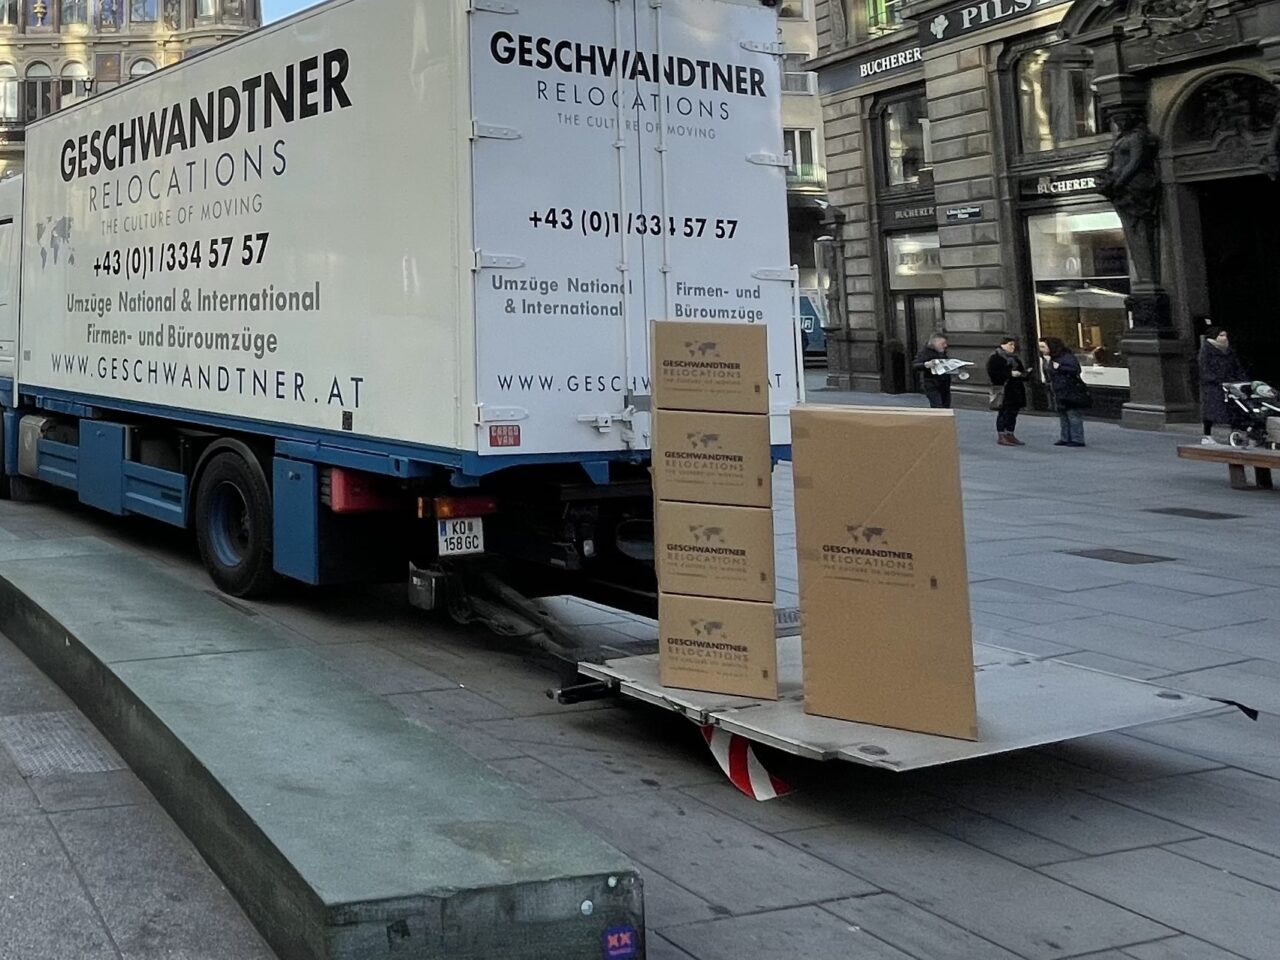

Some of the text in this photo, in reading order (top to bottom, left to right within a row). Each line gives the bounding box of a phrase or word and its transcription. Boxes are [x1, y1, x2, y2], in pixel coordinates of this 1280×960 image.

[490, 30, 767, 97] GESCHWANDTNER
[860, 47, 922, 77] BUCHERER
[537, 80, 729, 120] RELOCATIONS
[60, 48, 352, 182] GESCHWANDTNER
[557, 113, 580, 126] THE
[667, 125, 716, 140] MOVING
[88, 139, 287, 212] RELOCATIONS
[1037, 177, 1096, 194] BUCHERER
[101, 193, 264, 236] THE CULTURE OF MOVING
[529, 208, 573, 230] +43
[683, 217, 707, 238] 57
[715, 219, 738, 239] 57
[93, 249, 121, 277] +43
[208, 236, 233, 268] 57
[241, 232, 269, 266] 57
[491, 275, 558, 295] Umzüge
[676, 281, 761, 299] Firmen- und
[67, 282, 320, 318] Umzüge National & International
[504, 298, 623, 317] & International
[675, 303, 763, 323] Büroumzüge
[86, 323, 278, 359] Firmen- und Büroumzüge
[662, 359, 741, 370] GESCHWANDTNER
[51, 353, 364, 409] WWW.GESCHWANDTNER.AT
[664, 450, 744, 463] GESCHWANDTNER
[451, 520, 466, 535] KO
[666, 543, 747, 557] GESCHWANDTNER
[822, 544, 913, 560] GESCHWANDTNER
[667, 637, 749, 653] GESCHWANDTNER
